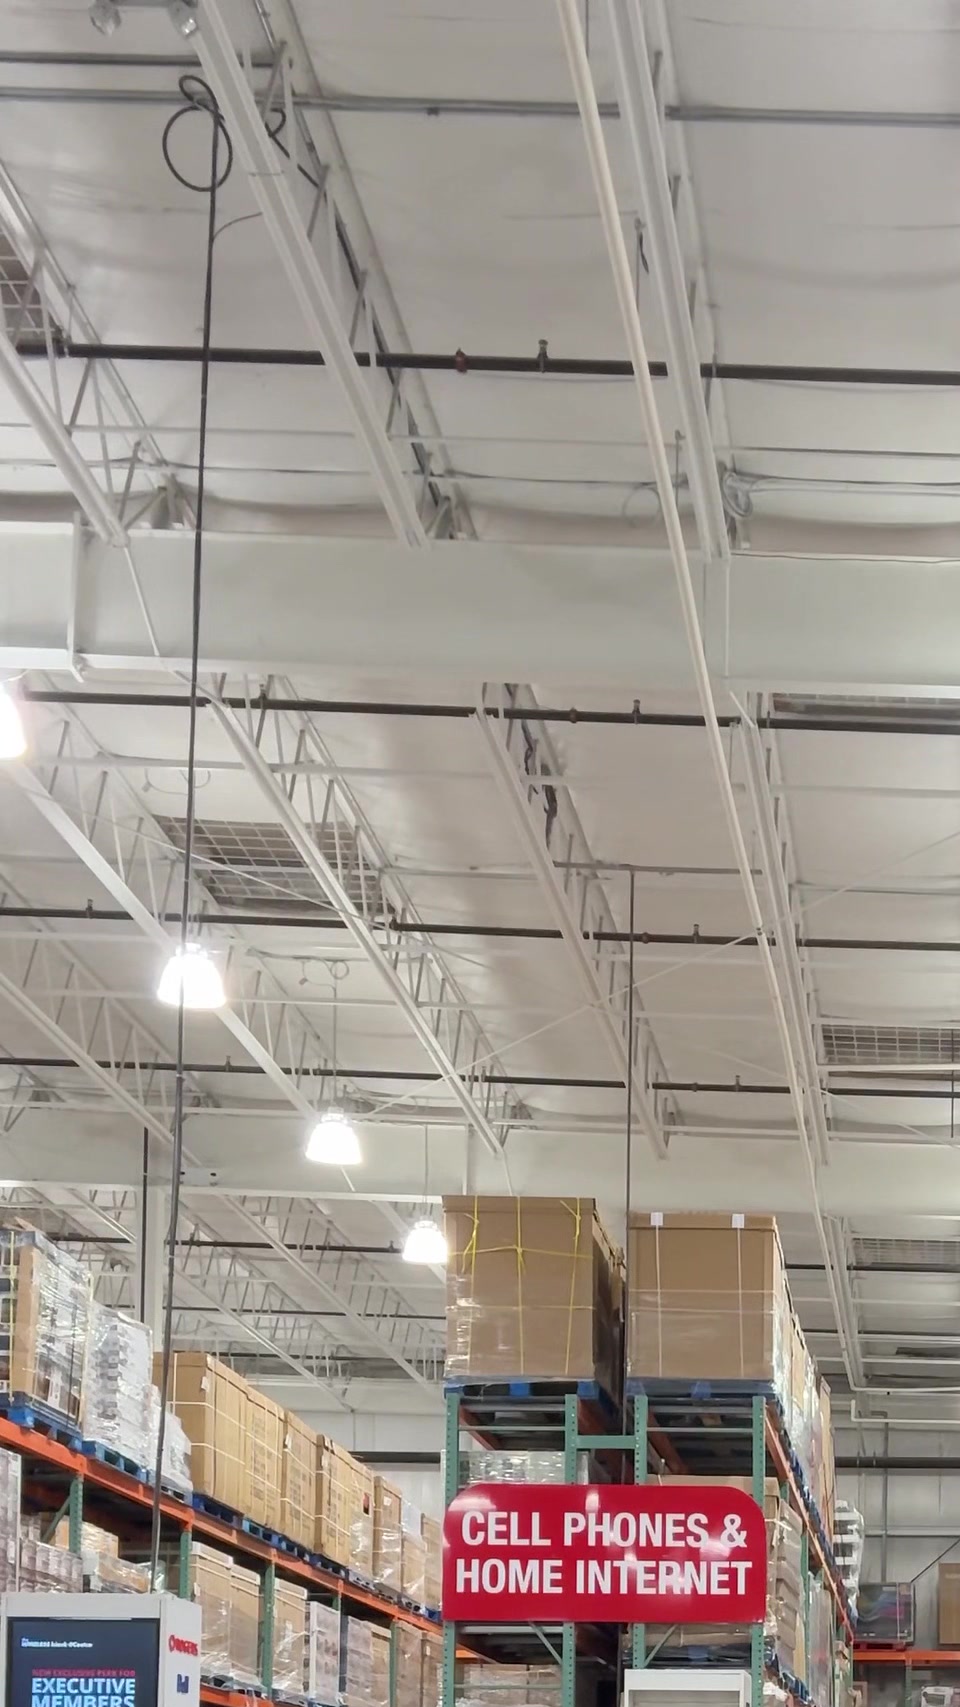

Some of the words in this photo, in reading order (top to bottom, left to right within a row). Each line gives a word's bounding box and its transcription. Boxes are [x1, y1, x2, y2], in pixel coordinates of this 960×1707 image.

[462, 1512, 551, 1547] CELL
[564, 1511, 709, 1547] PHONES
[721, 1512, 748, 1548] &
[455, 1559, 563, 1594] HOME
[576, 1560, 752, 1595] INTERNET
[31, 1678, 136, 1694] EXECUTIVE
